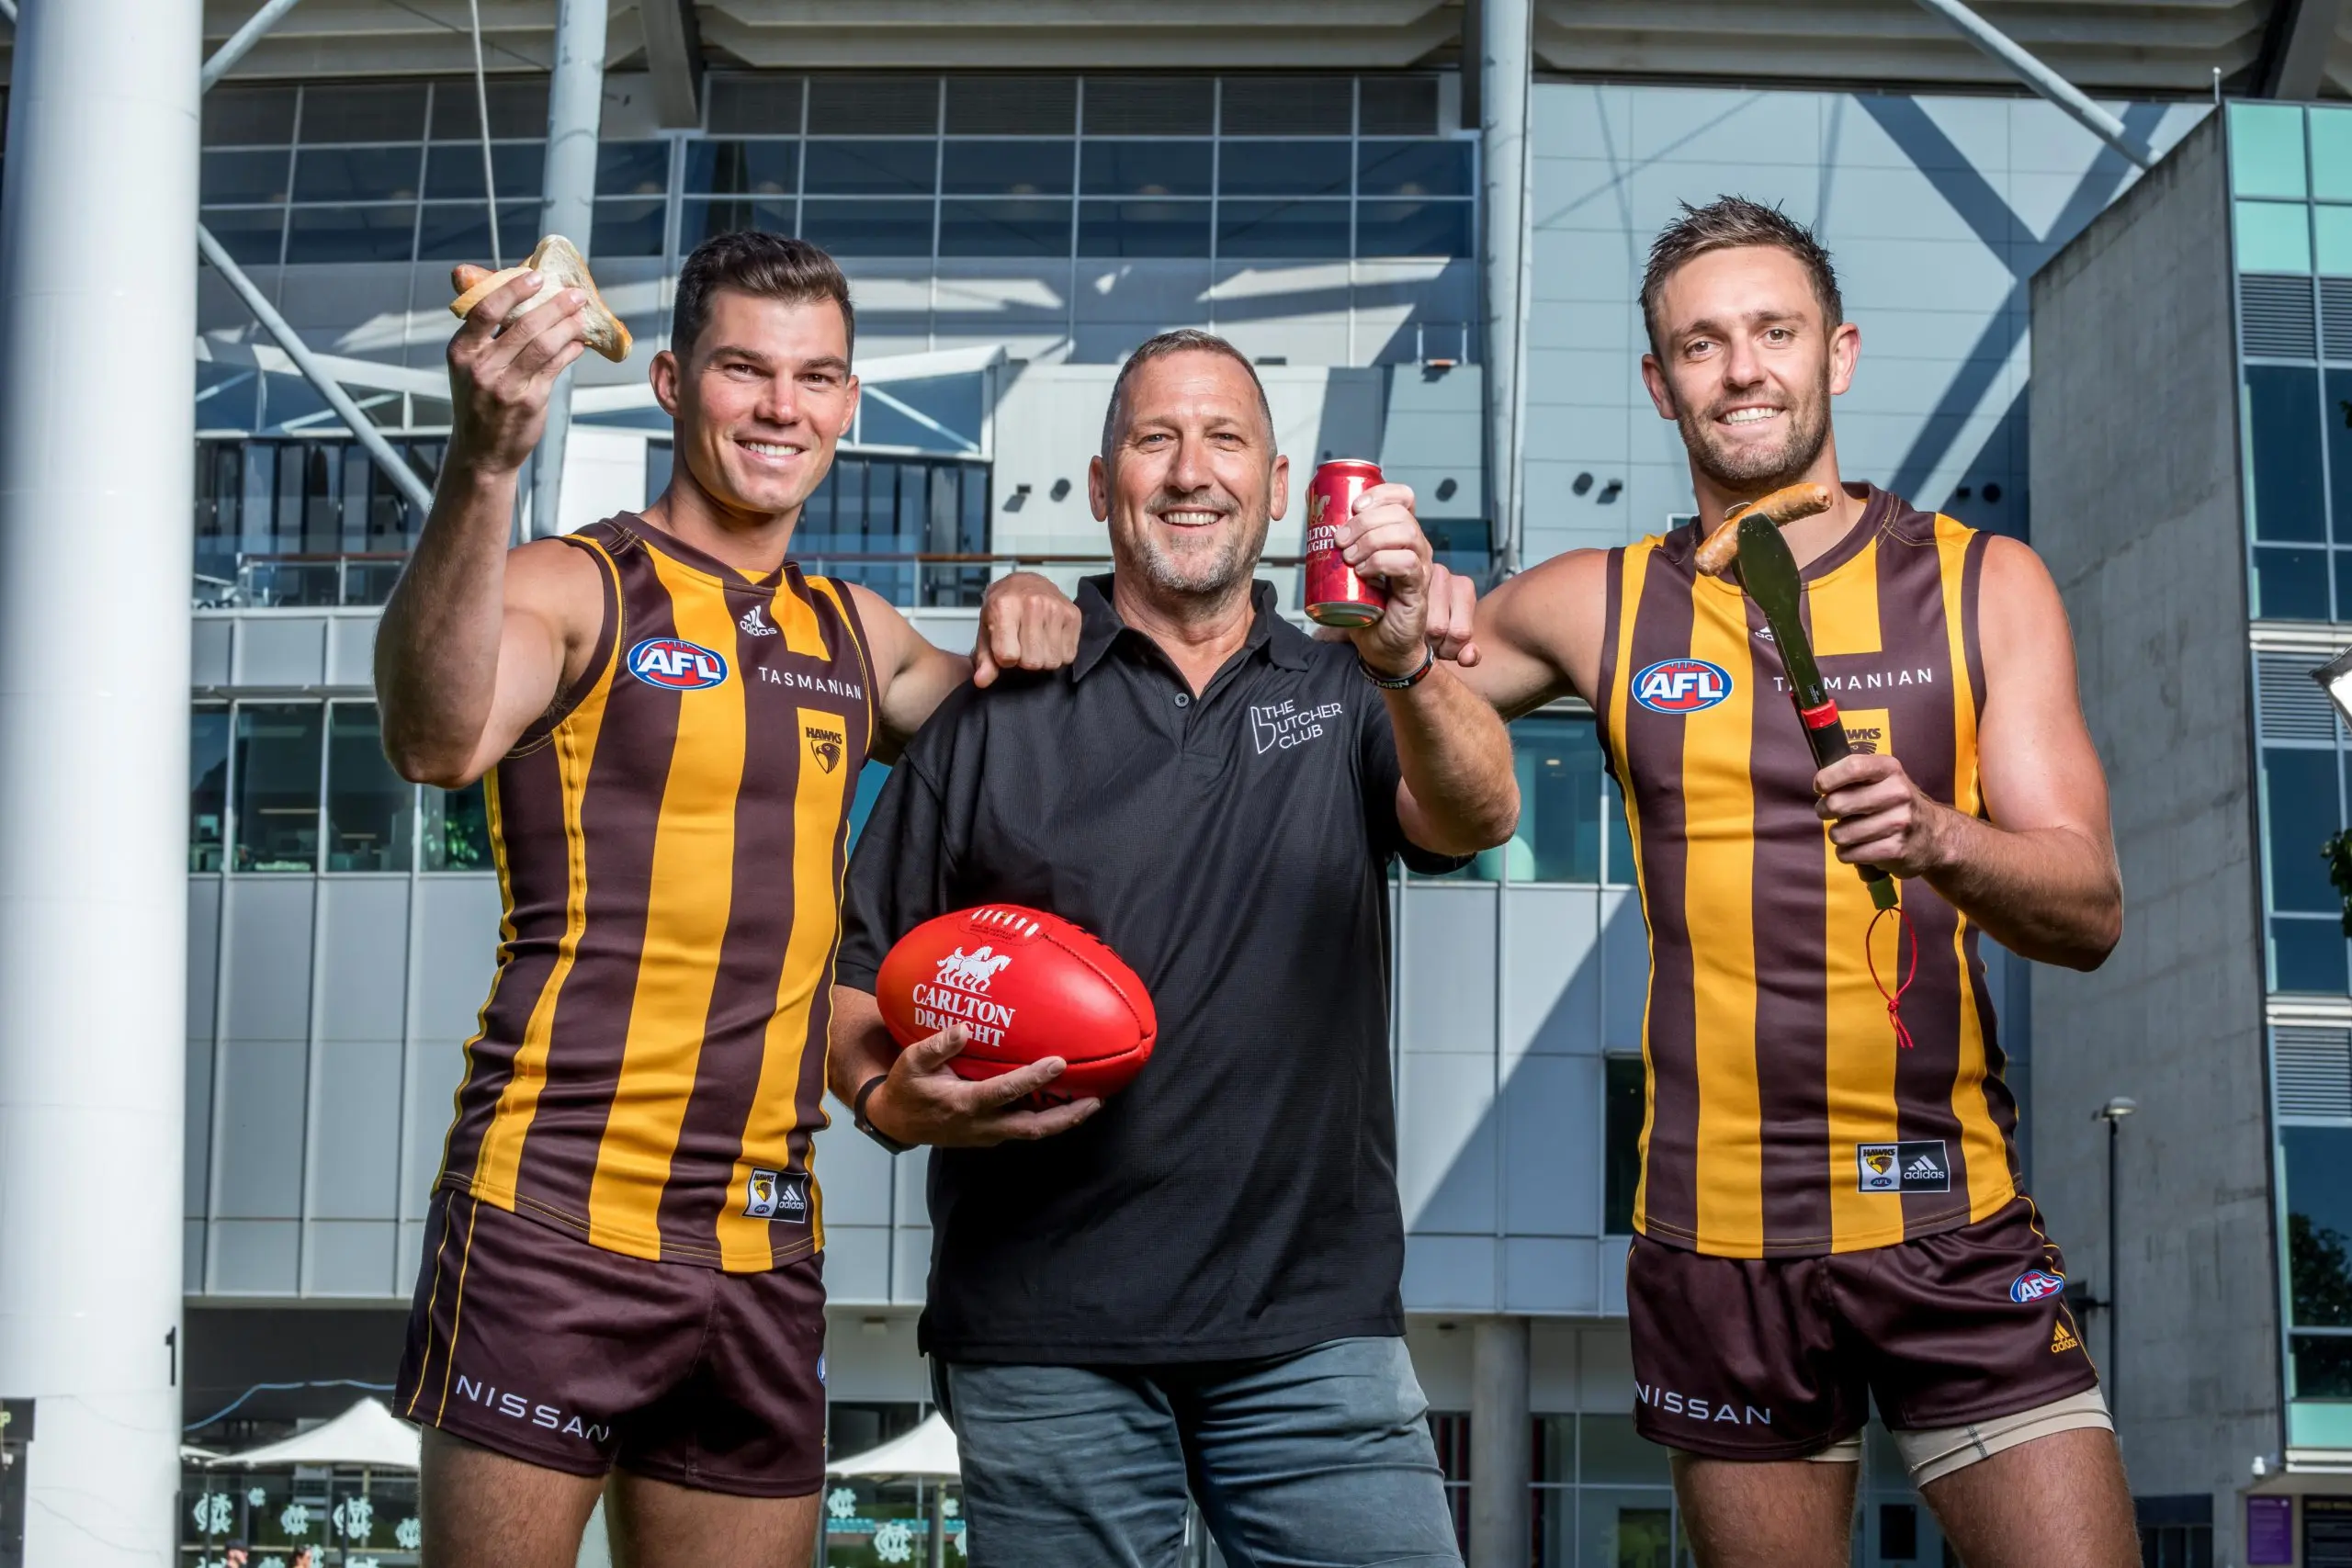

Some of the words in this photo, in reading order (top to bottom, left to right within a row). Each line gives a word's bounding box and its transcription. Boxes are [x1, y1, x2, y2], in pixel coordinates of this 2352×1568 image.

[1307, 525, 1339, 541] LTON
[740, 620, 777, 637] adidas
[636, 648, 721, 681] AFL
[758, 667, 862, 700] TASMANIAN
[1640, 671, 1724, 699] AFL
[1773, 668, 1932, 692] TMANIAN
[1261, 699, 1295, 719] THE
[806, 727, 842, 745] HAWKS
[1279, 724, 1323, 749] CLUB
[1845, 728, 1882, 739] WKS
[912, 983, 1016, 1028] CARLTON
[1863, 1148, 1895, 1156] HAWKS
[753, 1173, 775, 1182] HAWKS
[1904, 1169, 1945, 1179] adidas
[755, 1204, 768, 1213] AFL
[778, 1200, 804, 1210] adidas
[2021, 1277, 2062, 1302] AFL
[2051, 1337, 2078, 1354] adidas
[456, 1374, 610, 1443] NISSAN
[1635, 1381, 1771, 1425] NISSAN
